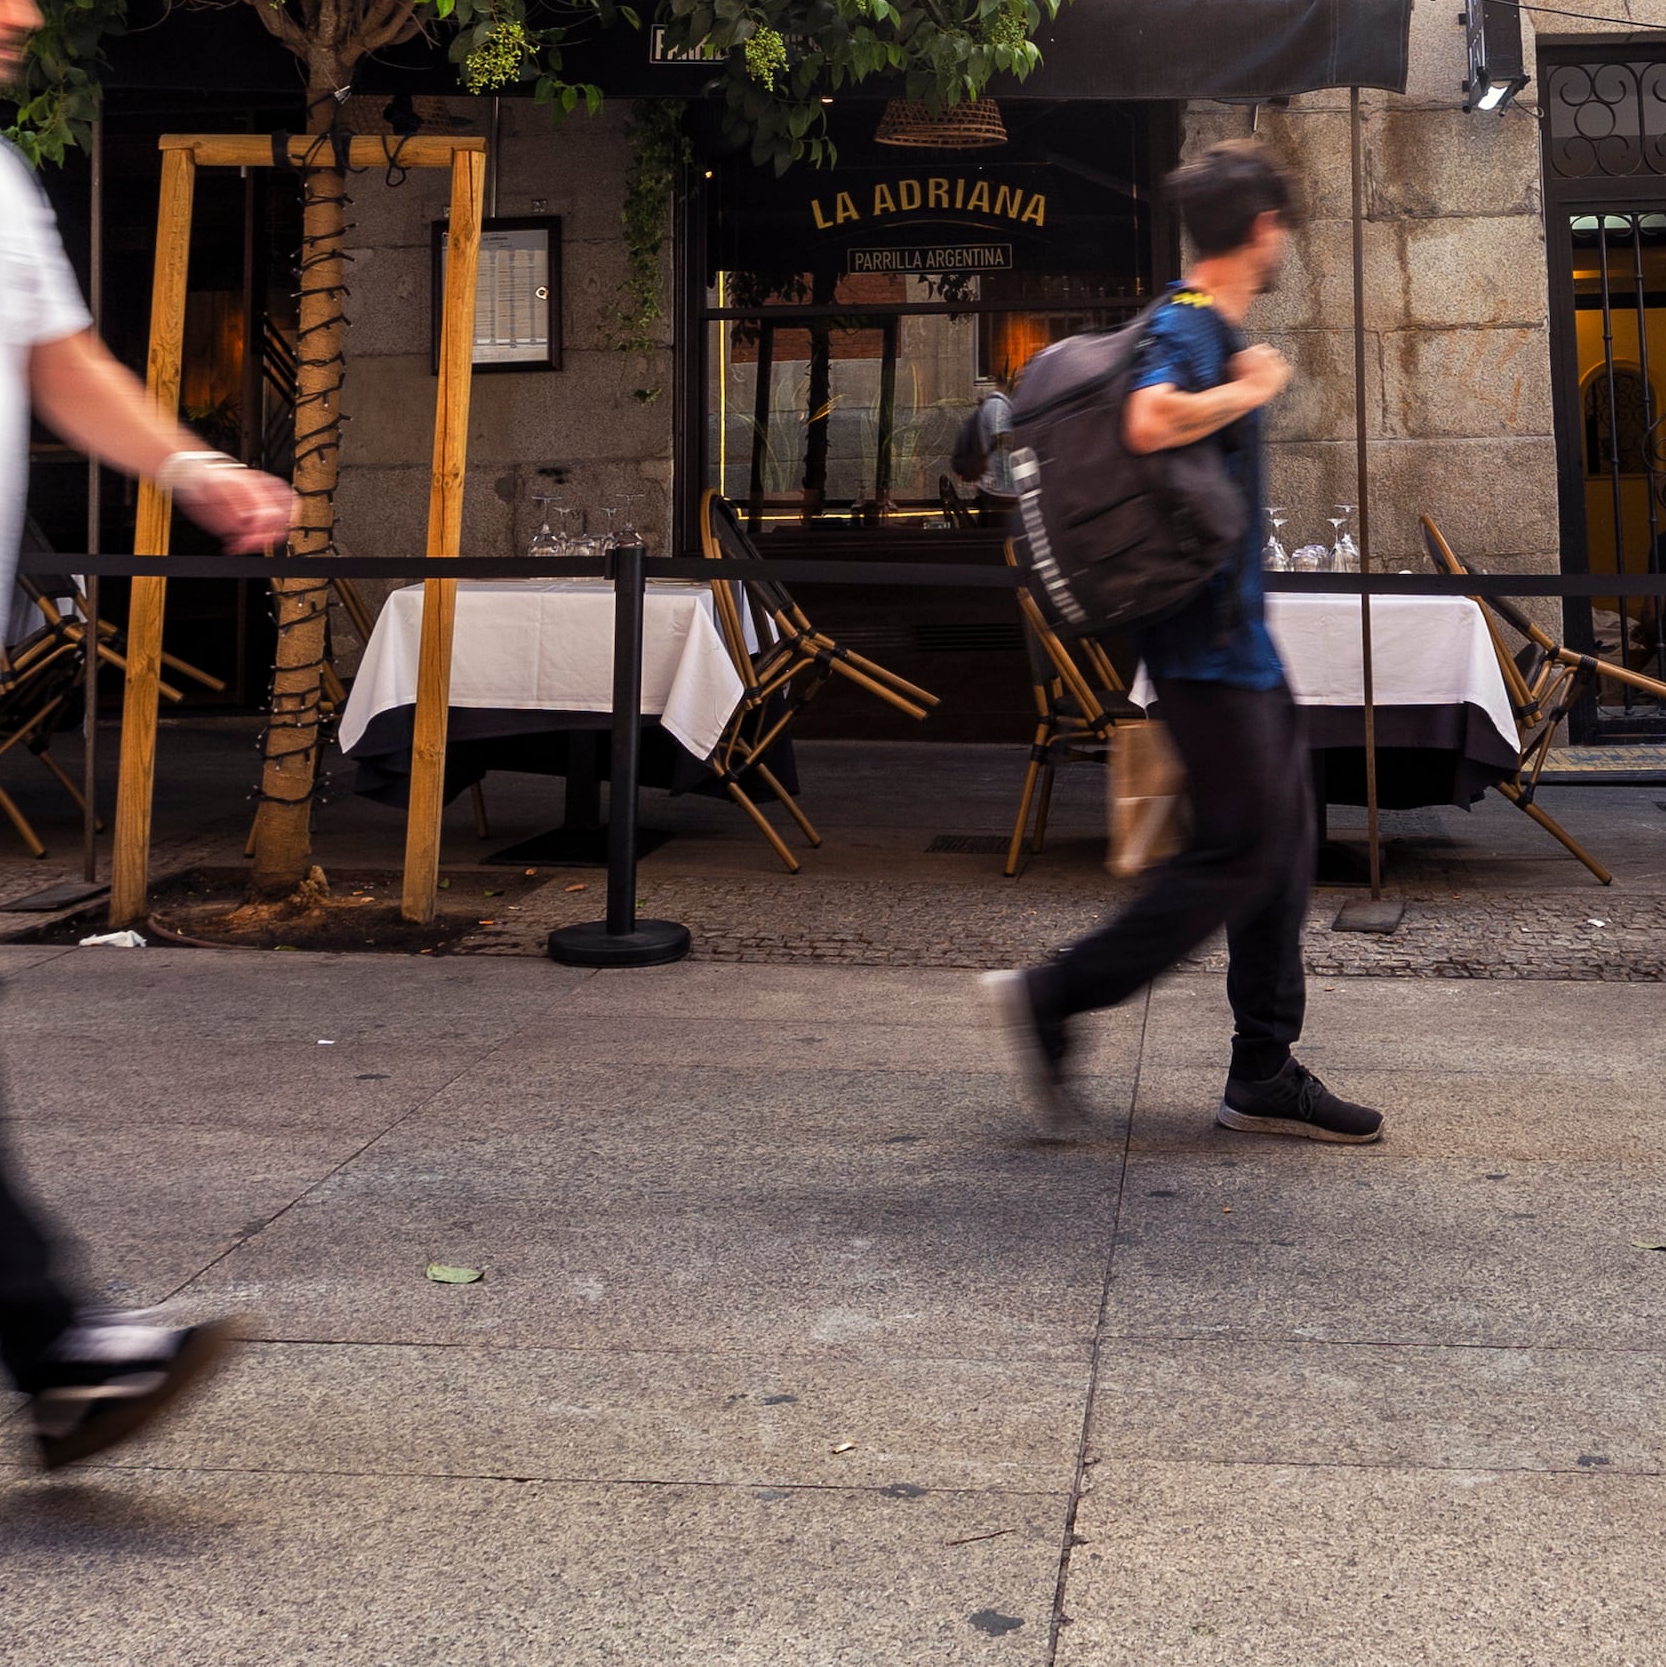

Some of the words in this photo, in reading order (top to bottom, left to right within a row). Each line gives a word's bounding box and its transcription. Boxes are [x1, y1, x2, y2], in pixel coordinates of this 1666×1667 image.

[811, 191, 861, 229] LA
[872, 178, 1046, 227] ADRIANA
[855, 249, 923, 271] PARRILLA
[925, 247, 1005, 269] ARGENTINA
